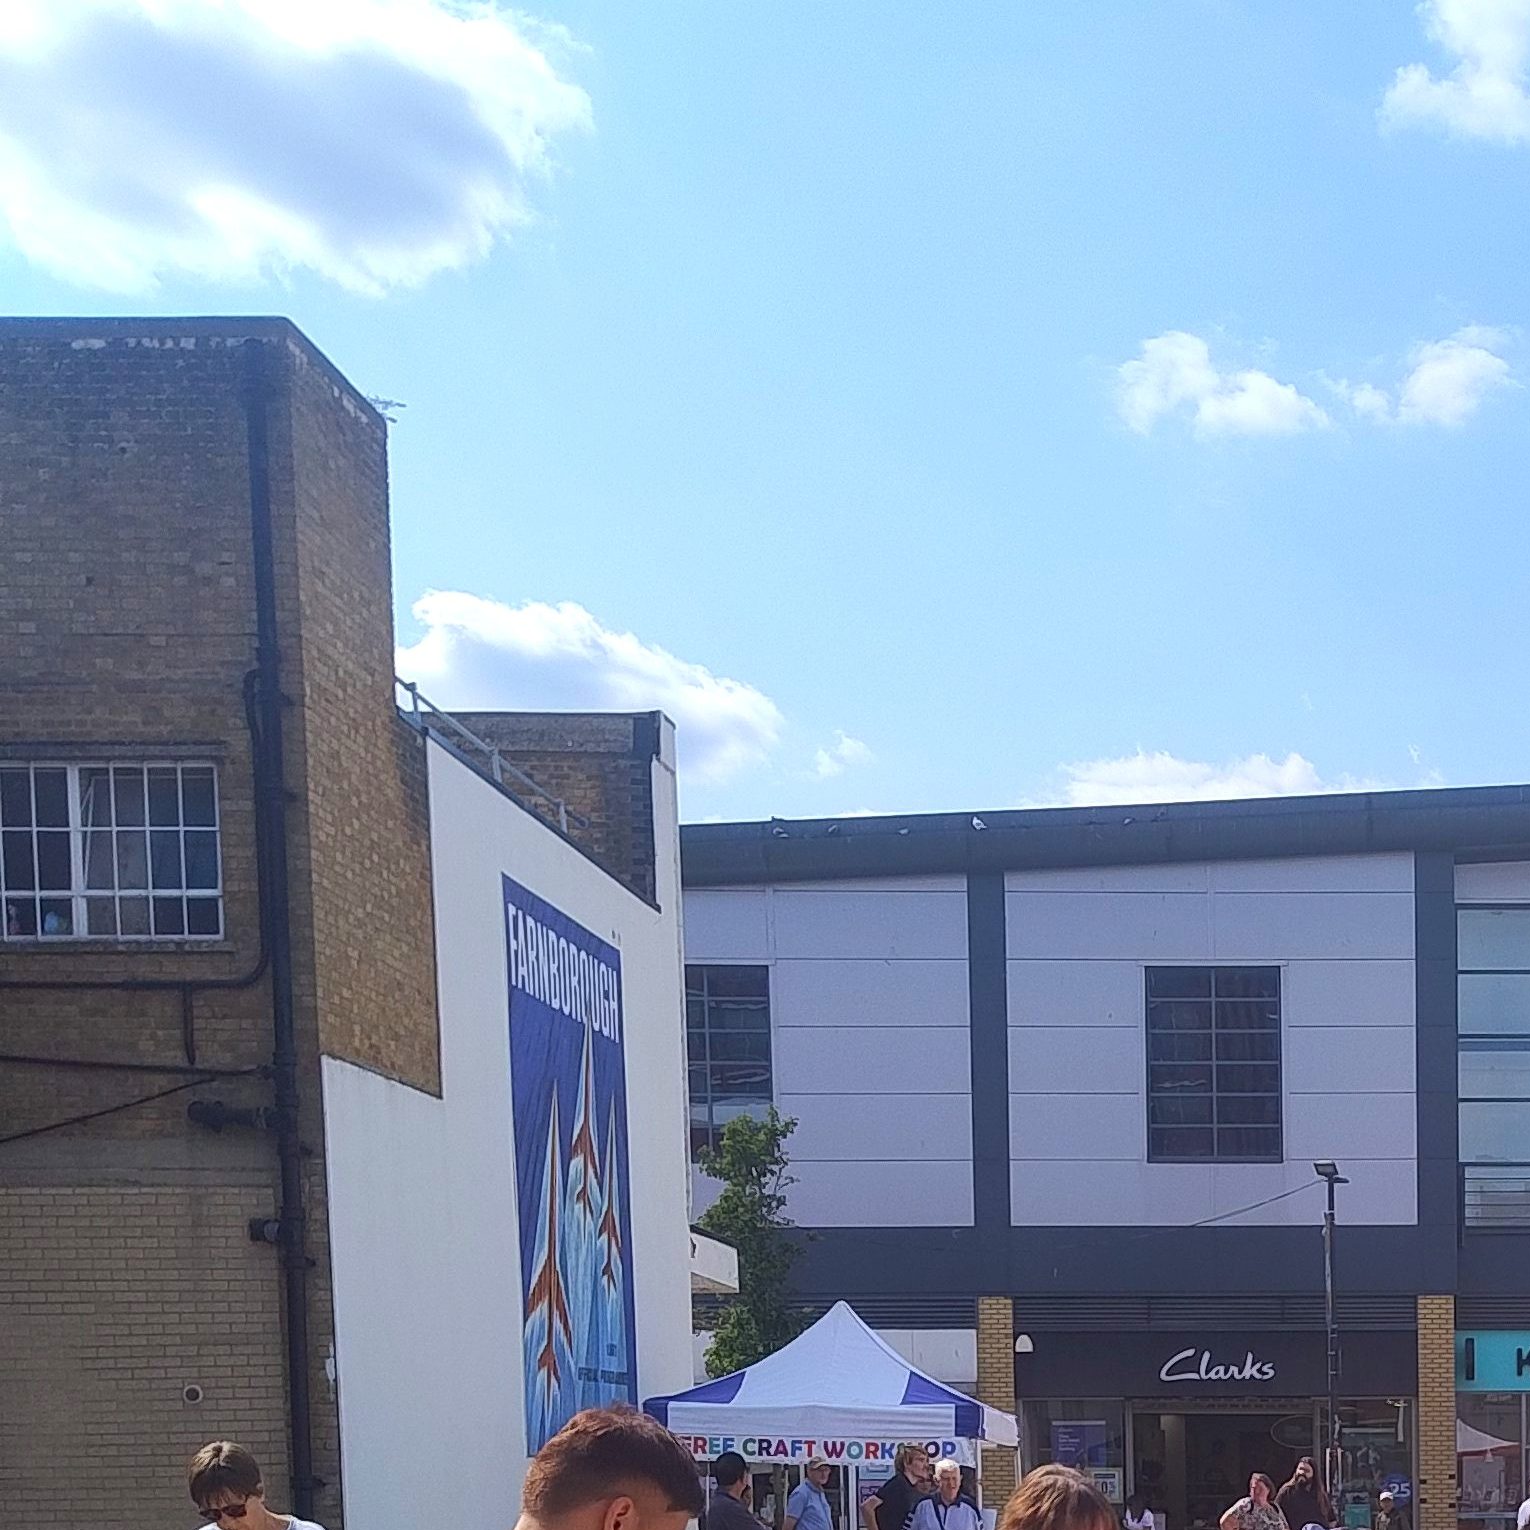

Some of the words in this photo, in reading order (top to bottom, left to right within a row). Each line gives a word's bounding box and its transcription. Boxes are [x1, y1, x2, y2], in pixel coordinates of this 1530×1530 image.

[507, 902, 620, 1044] FARNBOROUGH
[1160, 1347, 1276, 1382] Clarks
[742, 1437, 817, 1458] CRAFT
[823, 1440, 957, 1459] WORKOP
[1388, 1482, 1411, 1498] 25
